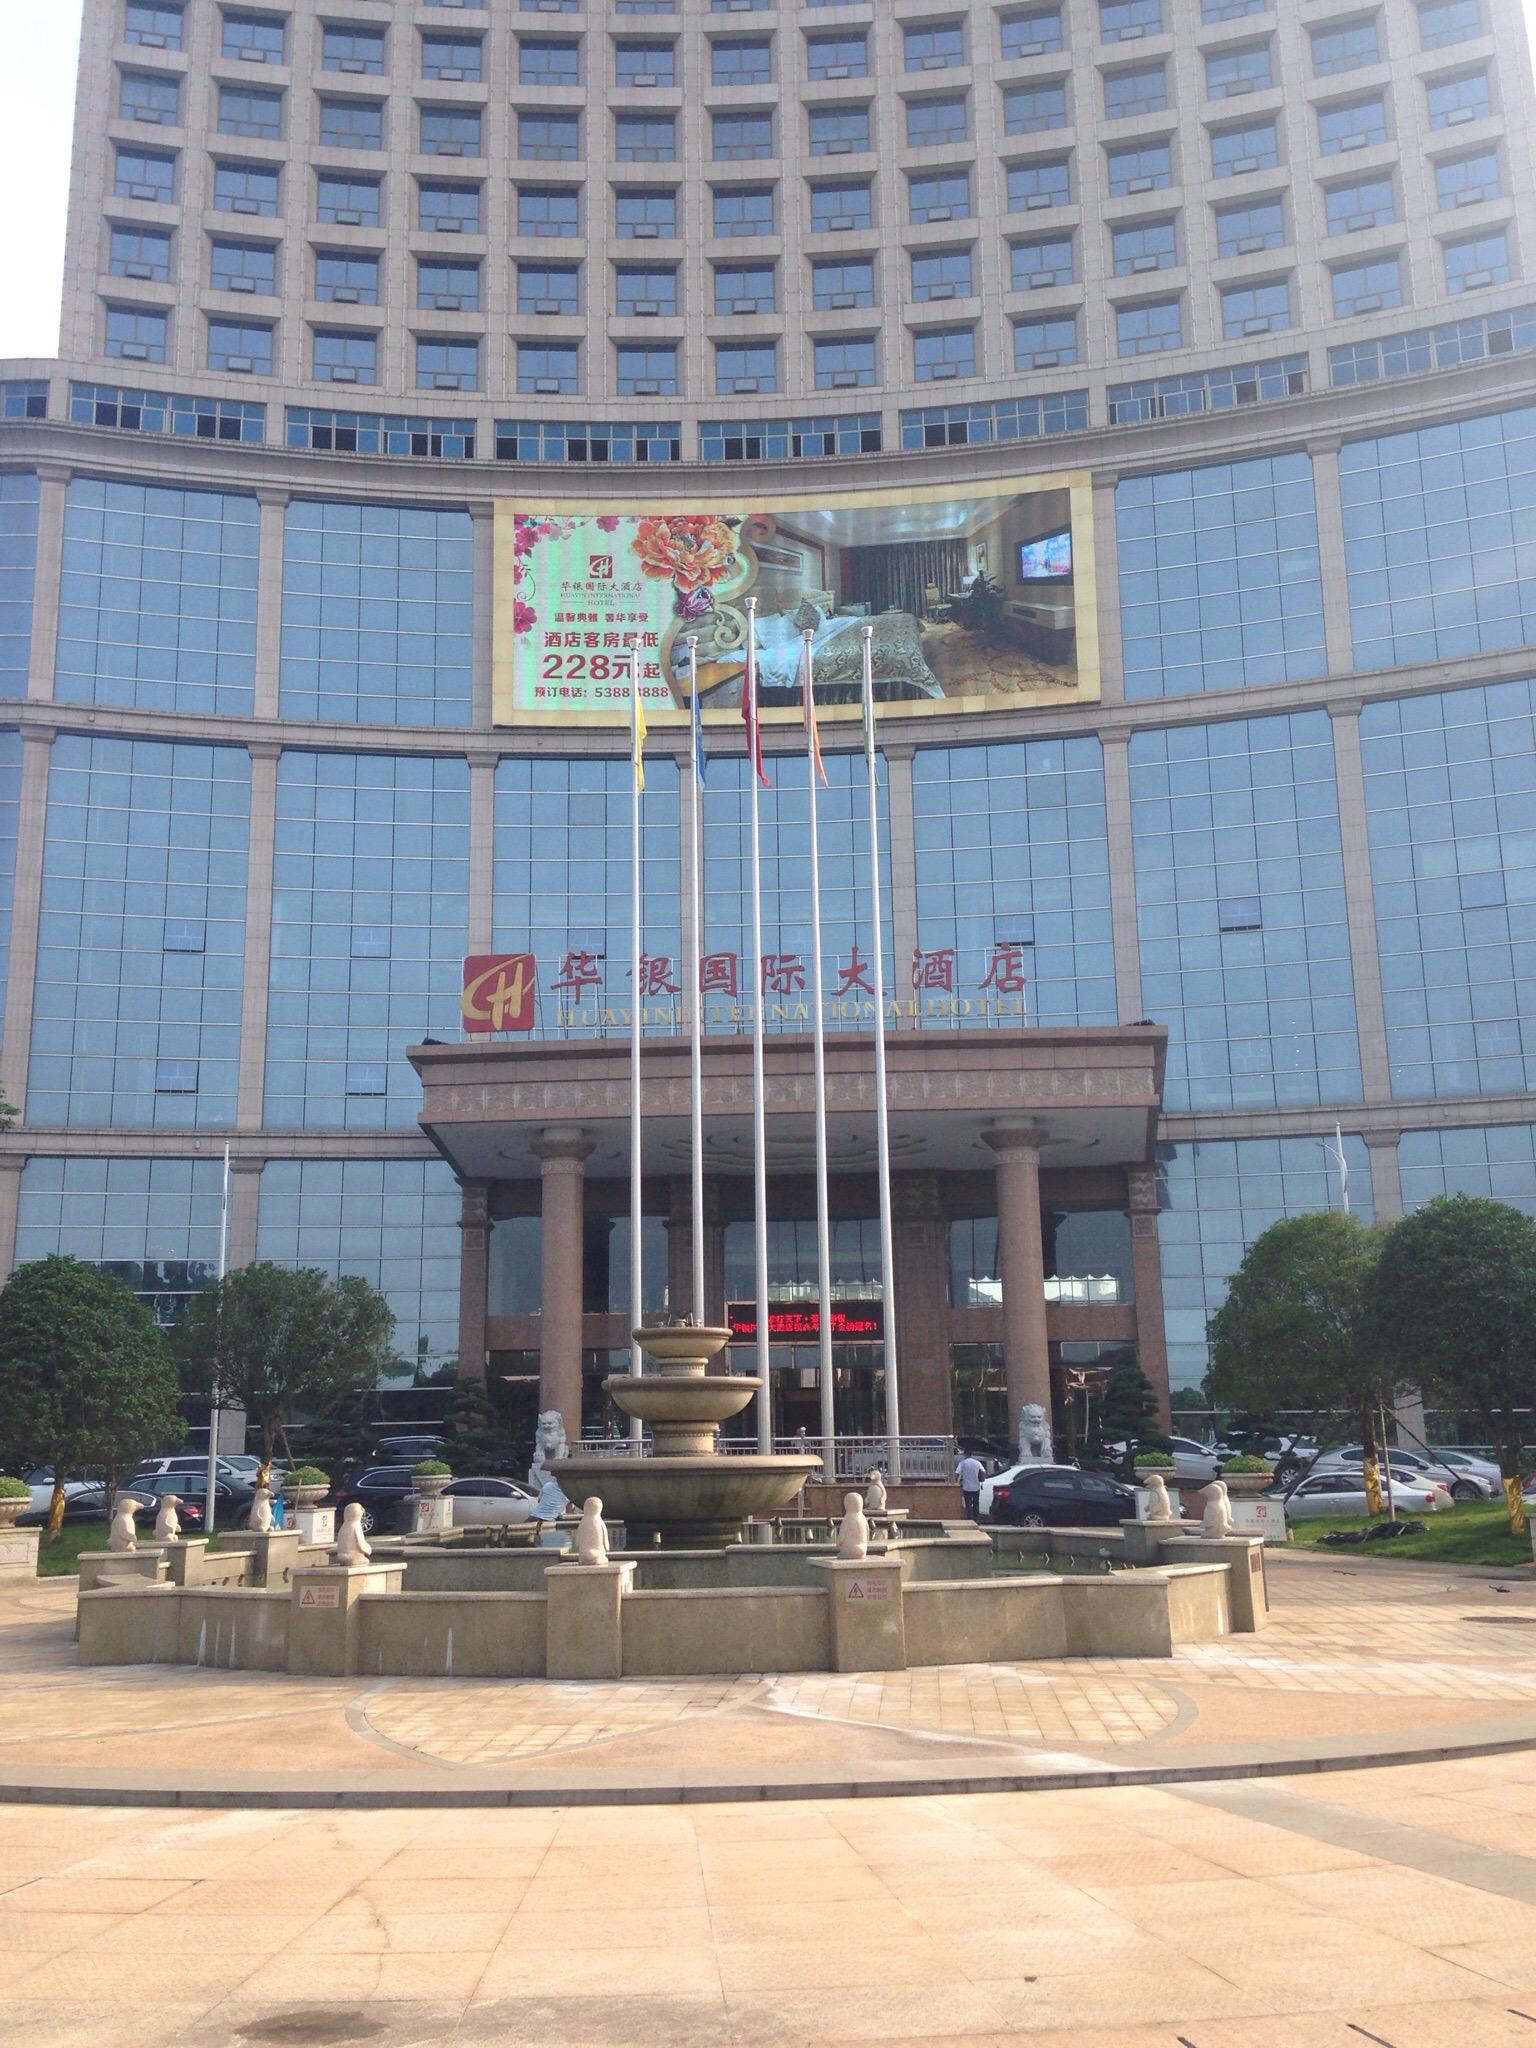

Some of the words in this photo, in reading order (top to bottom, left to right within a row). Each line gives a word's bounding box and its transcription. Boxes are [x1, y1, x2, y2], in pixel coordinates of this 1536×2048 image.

[561, 581, 643, 592] 华银国际大酒店
[554, 612, 598, 623] 温馨典雅
[605, 612, 649, 623] 奢华享受
[544, 631, 659, 648] 酒店客房最低
[550, 942, 1027, 1005] 华银国际大酒店
[556, 1007, 672, 1028] HUAYIN
[675, 1000, 922, 1024] ITENAIONAL
[927, 997, 1027, 1018] HOTEL
